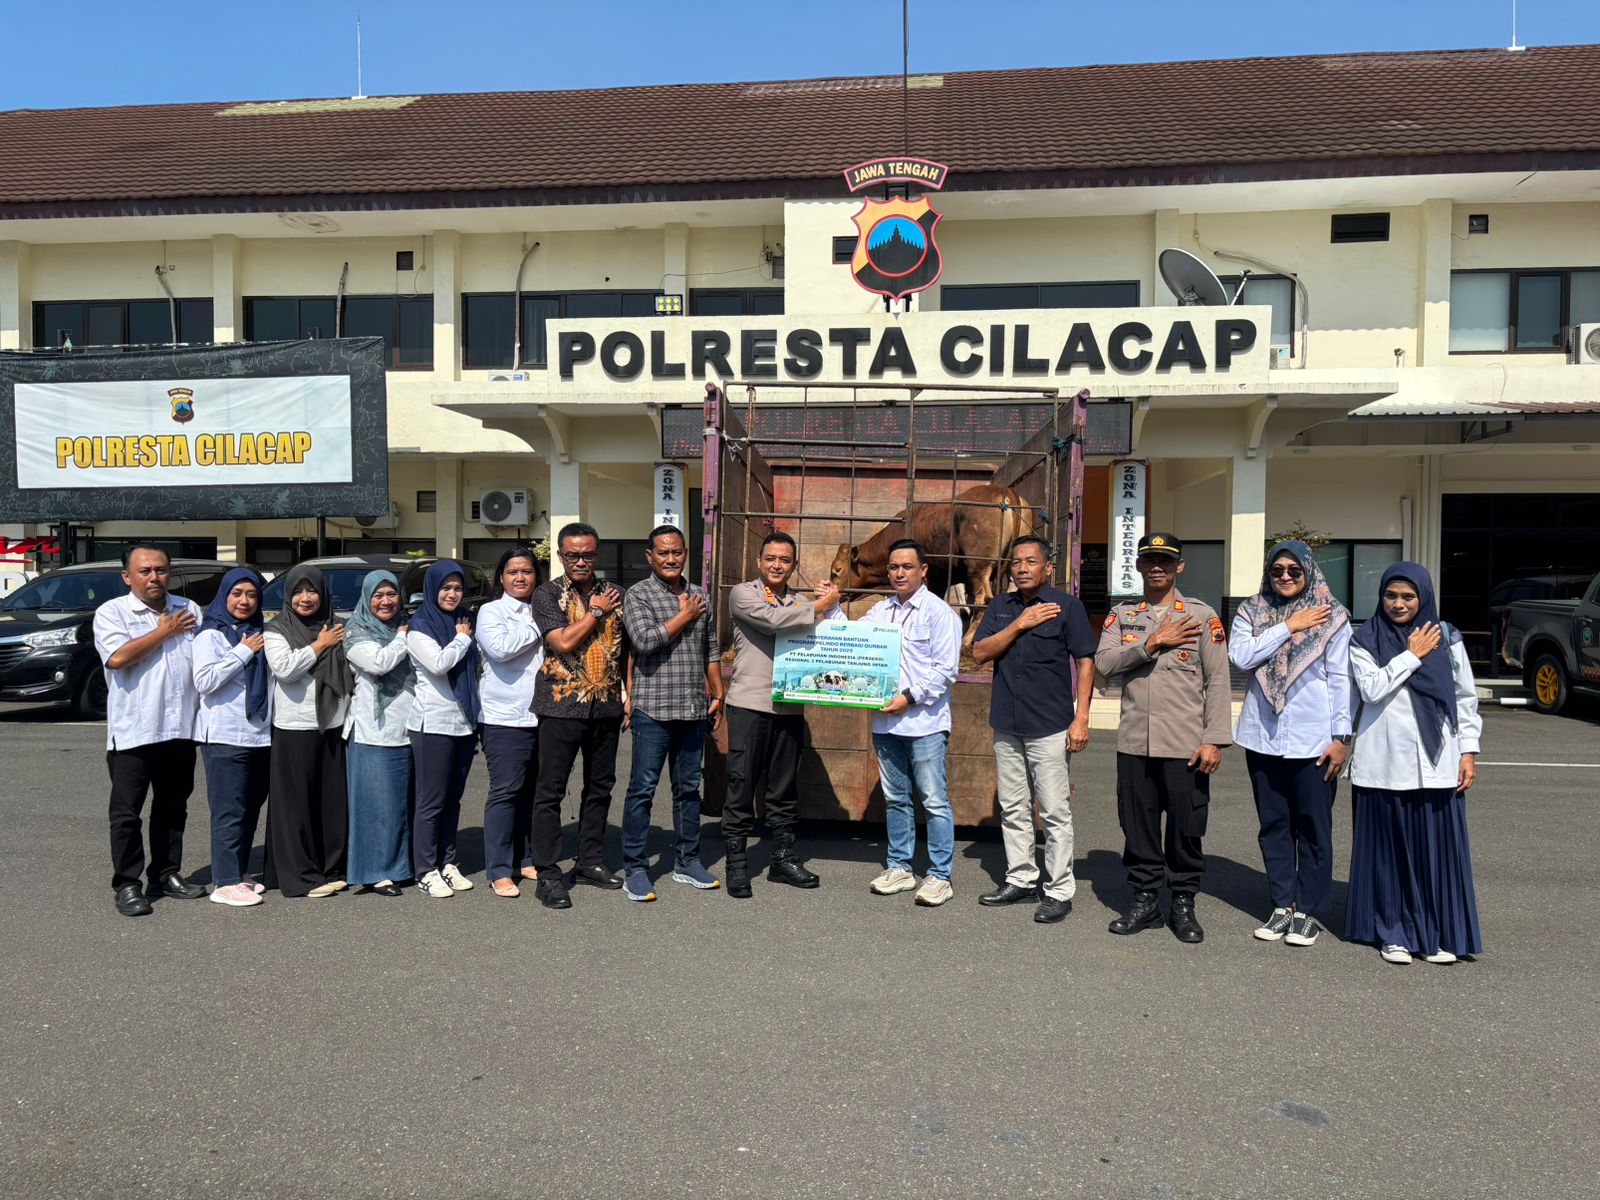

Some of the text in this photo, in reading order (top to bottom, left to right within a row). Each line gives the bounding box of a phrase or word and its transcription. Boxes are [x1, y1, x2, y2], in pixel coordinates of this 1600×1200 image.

[854, 162, 940, 183] JAWA TENGAH
[558, 318, 1258, 380] POLRESTA CILACAP
[56, 431, 312, 468] POLRESTA CILACAP
[662, 469, 675, 500] ZONA
[1121, 465, 1137, 589] ZONA INTEGRITAS
